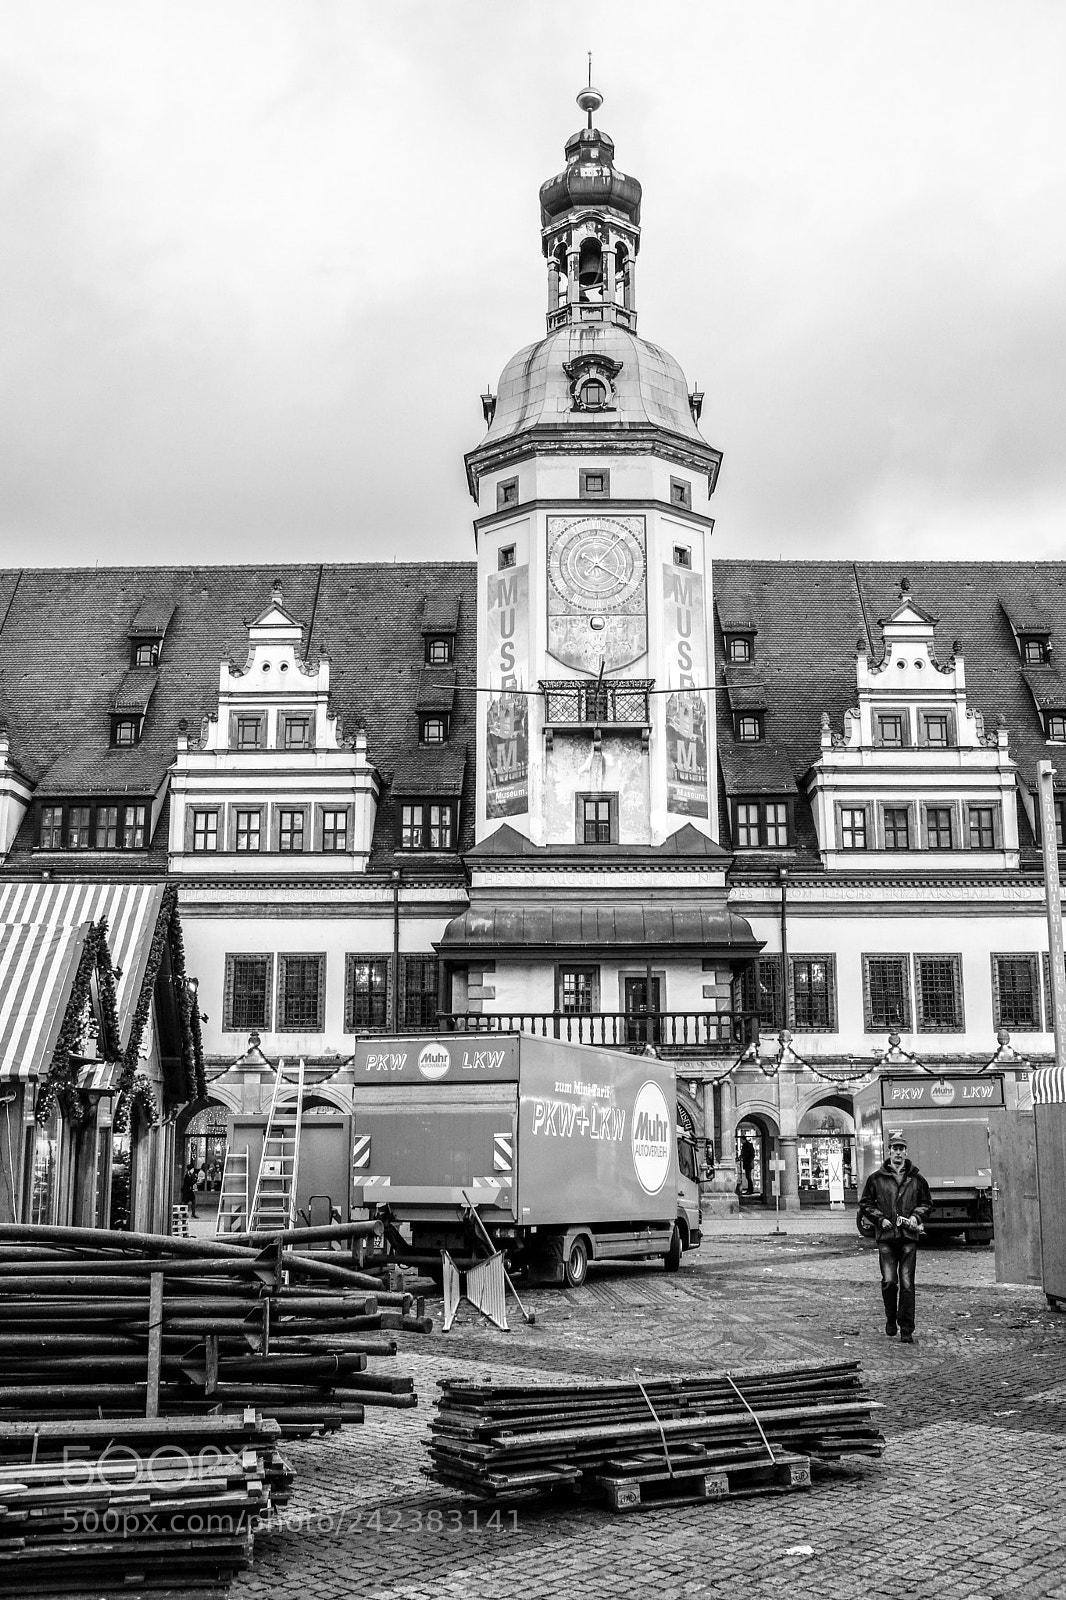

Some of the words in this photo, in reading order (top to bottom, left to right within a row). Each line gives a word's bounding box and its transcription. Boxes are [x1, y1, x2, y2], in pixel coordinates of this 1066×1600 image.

[366, 1053, 407, 1071] PKW
[420, 1052, 448, 1063] Muhr
[462, 1050, 506, 1069] LKW
[554, 1081, 572, 1094] zum
[573, 1080, 611, 1099] Mini-Tarif
[891, 1087, 924, 1100] PKW
[931, 1087, 953, 1095] Muhr
[962, 1085, 994, 1099] LKW
[532, 1100, 626, 1142] PKW+LKW
[634, 1111, 668, 1143] Muhr
